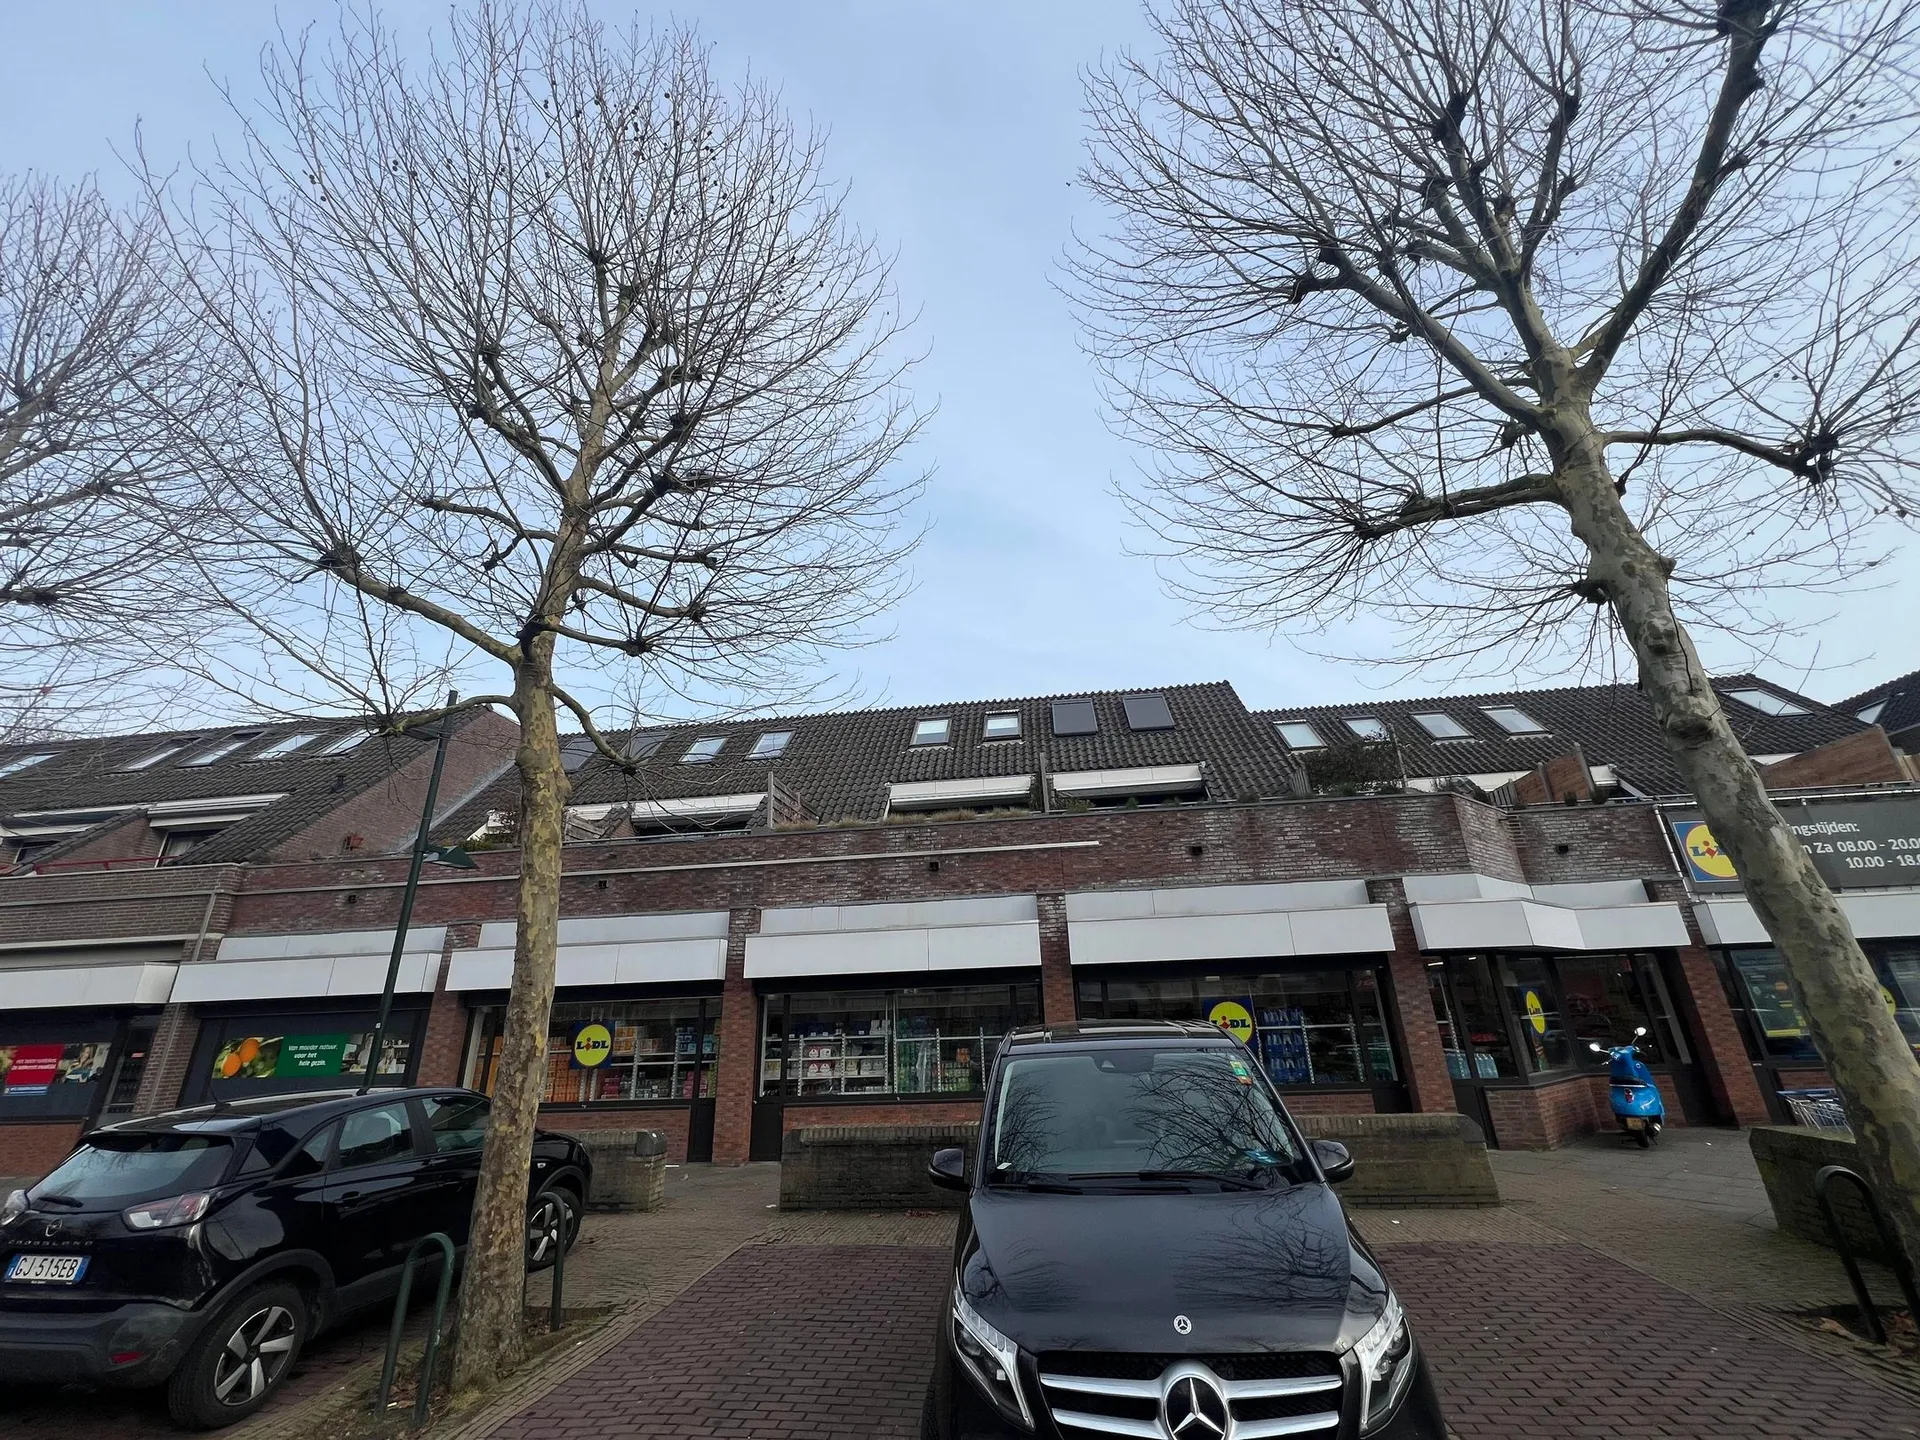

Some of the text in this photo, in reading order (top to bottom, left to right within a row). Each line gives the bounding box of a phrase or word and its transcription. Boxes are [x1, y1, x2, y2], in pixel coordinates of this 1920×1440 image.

[1787, 821, 1860, 837] ngstijden:
[1813, 842, 1834, 854] Za
[1837, 840, 1877, 852] 08.00
[1887, 837, 1920, 850] 20.0
[1846, 856, 1885, 869] 10.00
